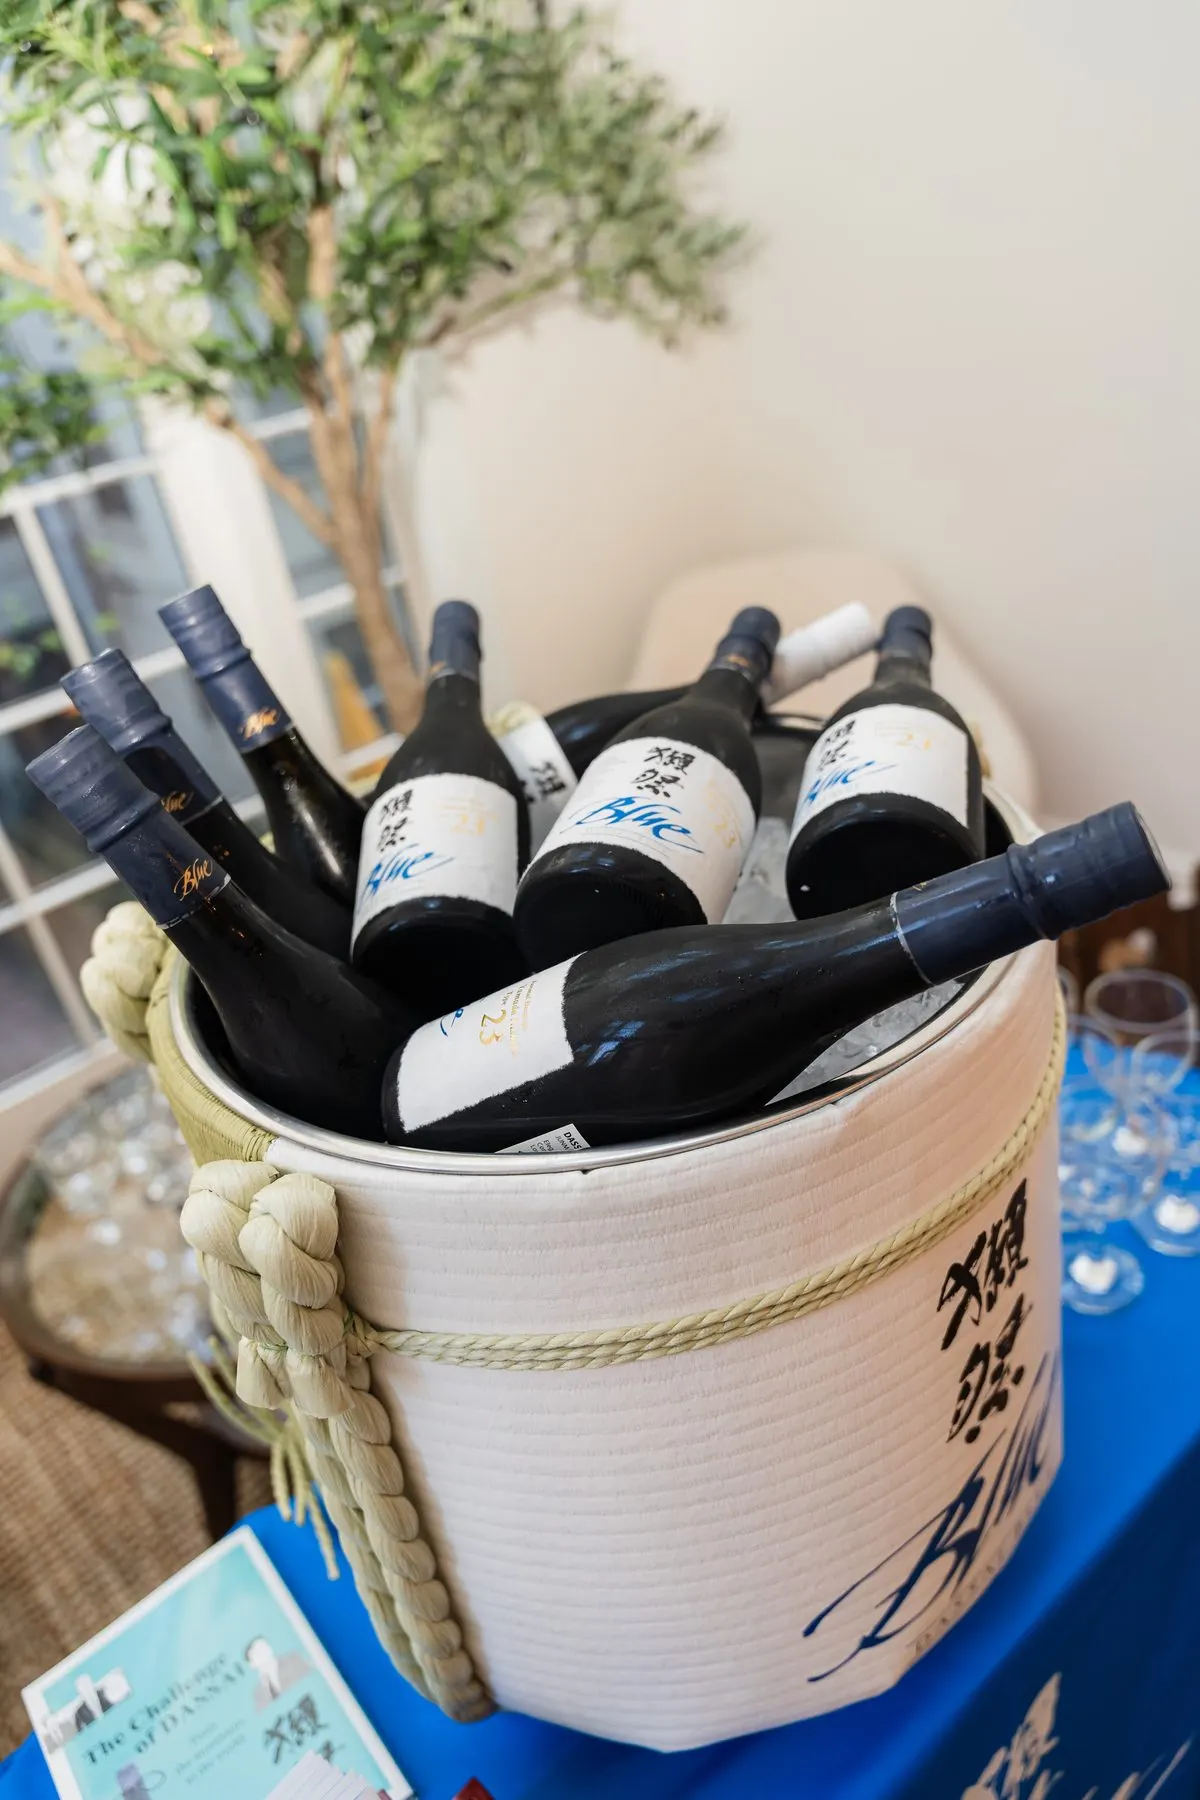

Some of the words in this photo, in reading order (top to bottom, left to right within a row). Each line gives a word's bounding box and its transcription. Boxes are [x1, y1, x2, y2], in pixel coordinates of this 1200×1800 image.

[560, 796, 704, 855] Blue
[173, 858, 213, 901] Blue
[479, 1008, 507, 1046] 23
[563, 1131, 582, 1150] DASS
[84, 1731, 125, 1766] The
[134, 1727, 156, 1754] of
